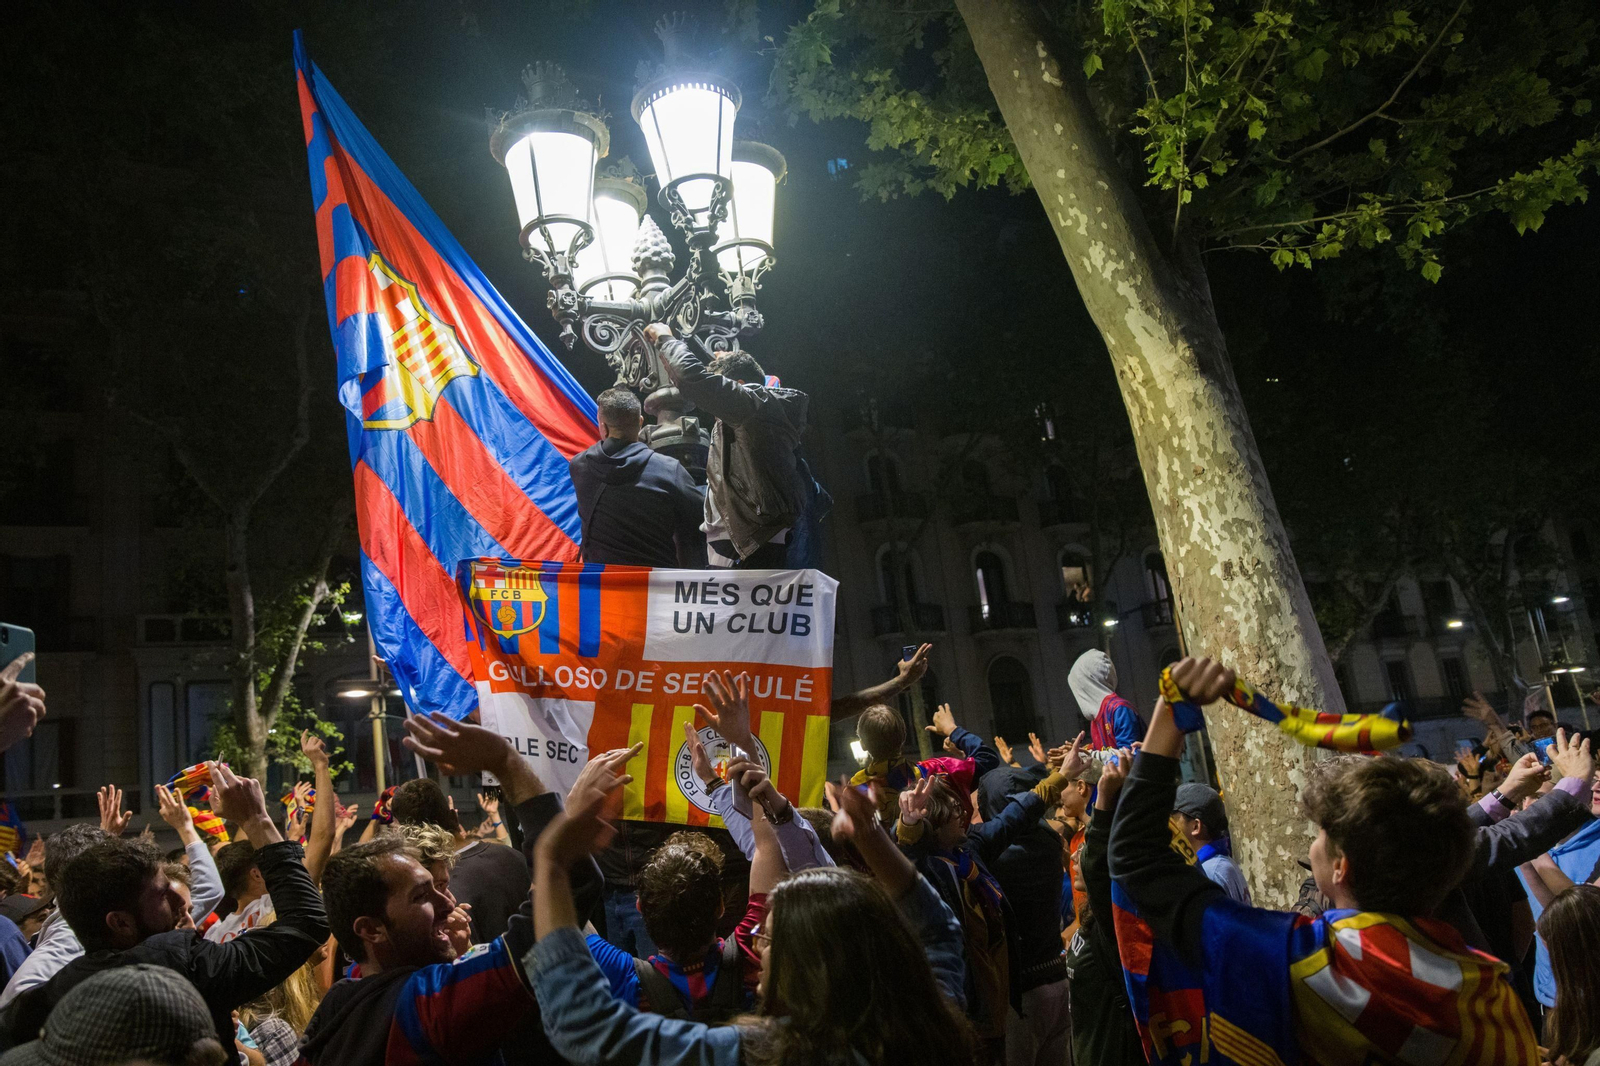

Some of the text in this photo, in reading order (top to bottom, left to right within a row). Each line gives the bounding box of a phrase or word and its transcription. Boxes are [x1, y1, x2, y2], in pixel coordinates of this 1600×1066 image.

[675, 577, 814, 607] MÉS QUE
[673, 611, 811, 636] UN CLUB
[488, 660, 608, 690] GULLOSO
[615, 669, 655, 692] DE
[546, 740, 579, 764] SEC
[680, 746, 698, 797] FOOT-B
